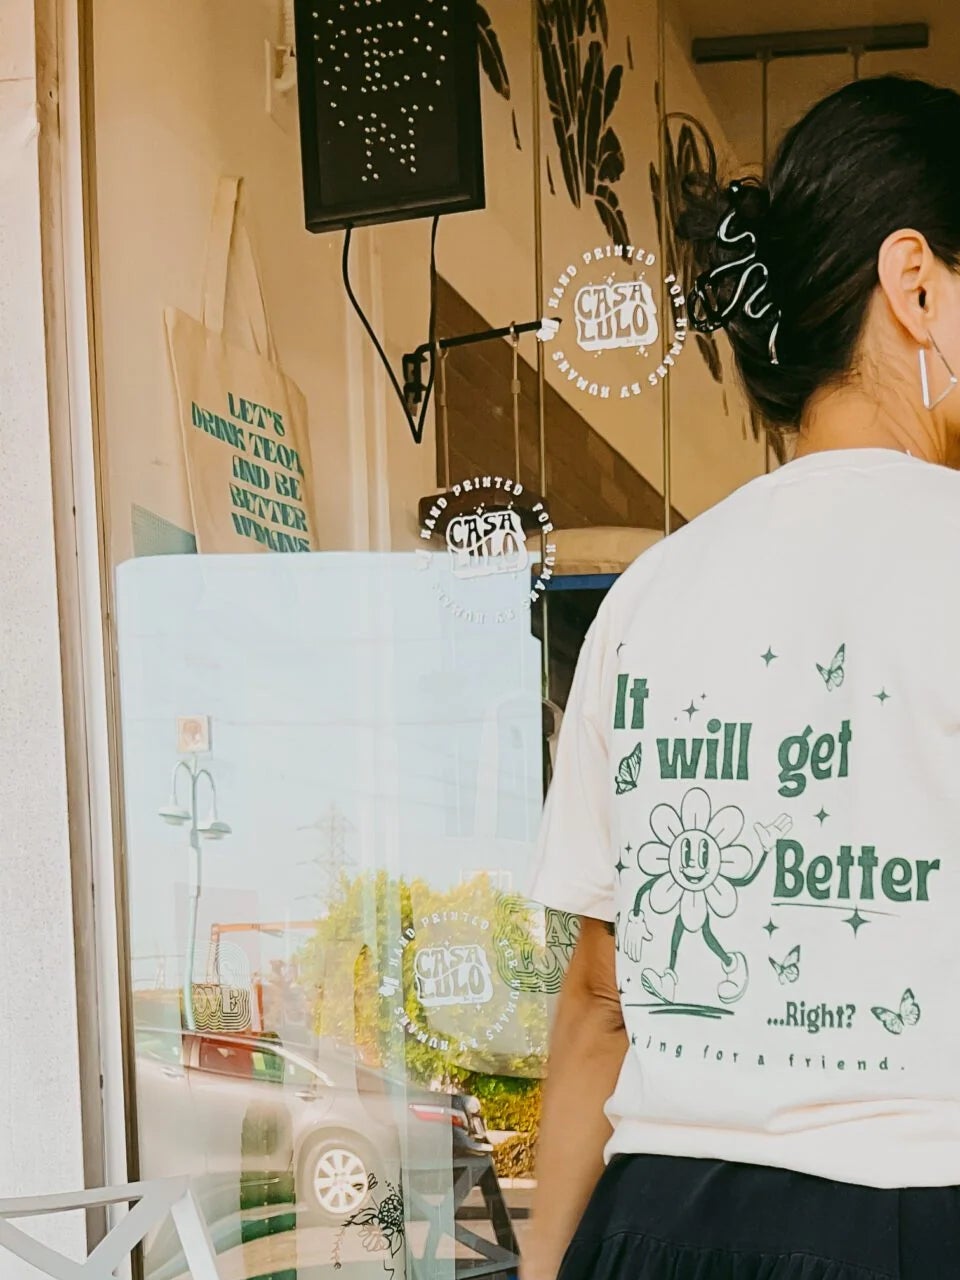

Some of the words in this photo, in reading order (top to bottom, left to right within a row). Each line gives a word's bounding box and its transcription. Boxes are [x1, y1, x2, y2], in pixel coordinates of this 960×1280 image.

[582, 245, 656, 266] PRINTED
[548, 265, 577, 309] HAND
[577, 284, 648, 319] CASA
[664, 273, 686, 307] FOR
[579, 304, 649, 342] LULO
[648, 317, 688, 386] HUMANS
[552, 351, 610, 399] HUMANS
[620, 382, 641, 399] BY
[191, 401, 246, 451] DRINK
[228, 392, 285, 437] LET'S
[274, 471, 302, 501] BE
[229, 482, 308, 532] BETTER
[420, 497, 448, 540] HAND
[452, 476, 523, 497] PRINTED
[532, 502, 554, 534] FOR
[450, 513, 517, 549] CASA
[451, 532, 519, 570] LULO
[613, 673, 650, 730] It
[656, 718, 752, 781] will
[777, 719, 853, 798] get
[773, 838, 941, 902] Better
[421, 911, 490, 930] PRINTED
[389, 927, 416, 967] HAND
[416, 947, 482, 980] CASA
[499, 939, 518, 969] FOR
[419, 965, 485, 999] LULO
[394, 1006, 449, 1051] HUMANS
[486, 979, 521, 1041] HUMANS
[766, 1000, 857, 1034] ...Right?
[459, 1038, 478, 1051] BY
[702, 1045, 738, 1063] for
[757, 1054, 765, 1066] a
[788, 1053, 906, 1071] friend.
